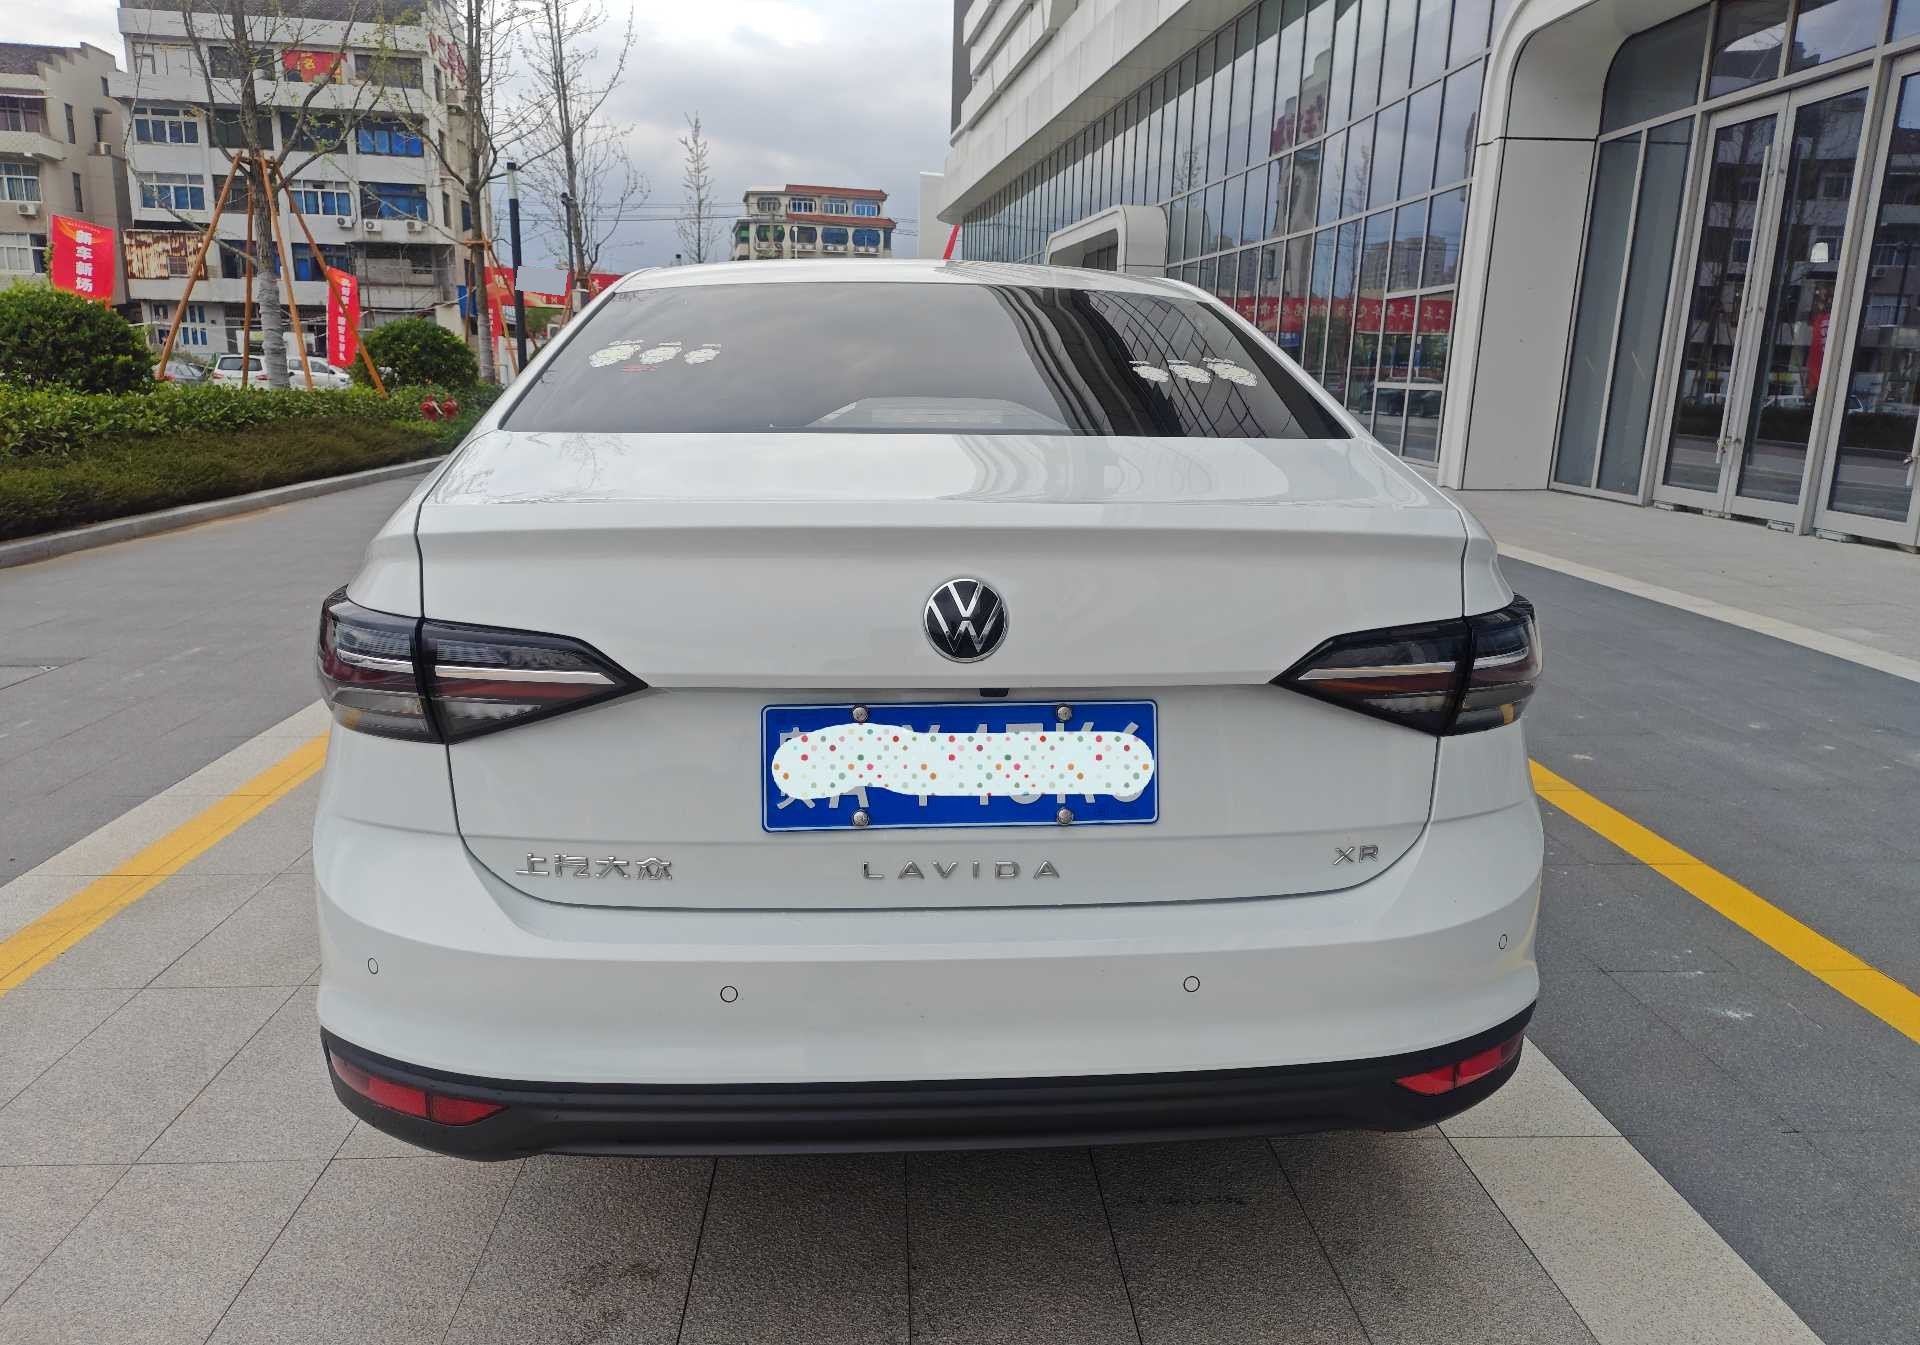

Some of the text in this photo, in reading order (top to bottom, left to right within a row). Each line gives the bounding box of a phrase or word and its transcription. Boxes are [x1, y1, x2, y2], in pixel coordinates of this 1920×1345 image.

[1332, 845, 1379, 865] XR
[515, 853, 673, 880] 上汽大众
[862, 859, 1061, 881] LAVIDA
